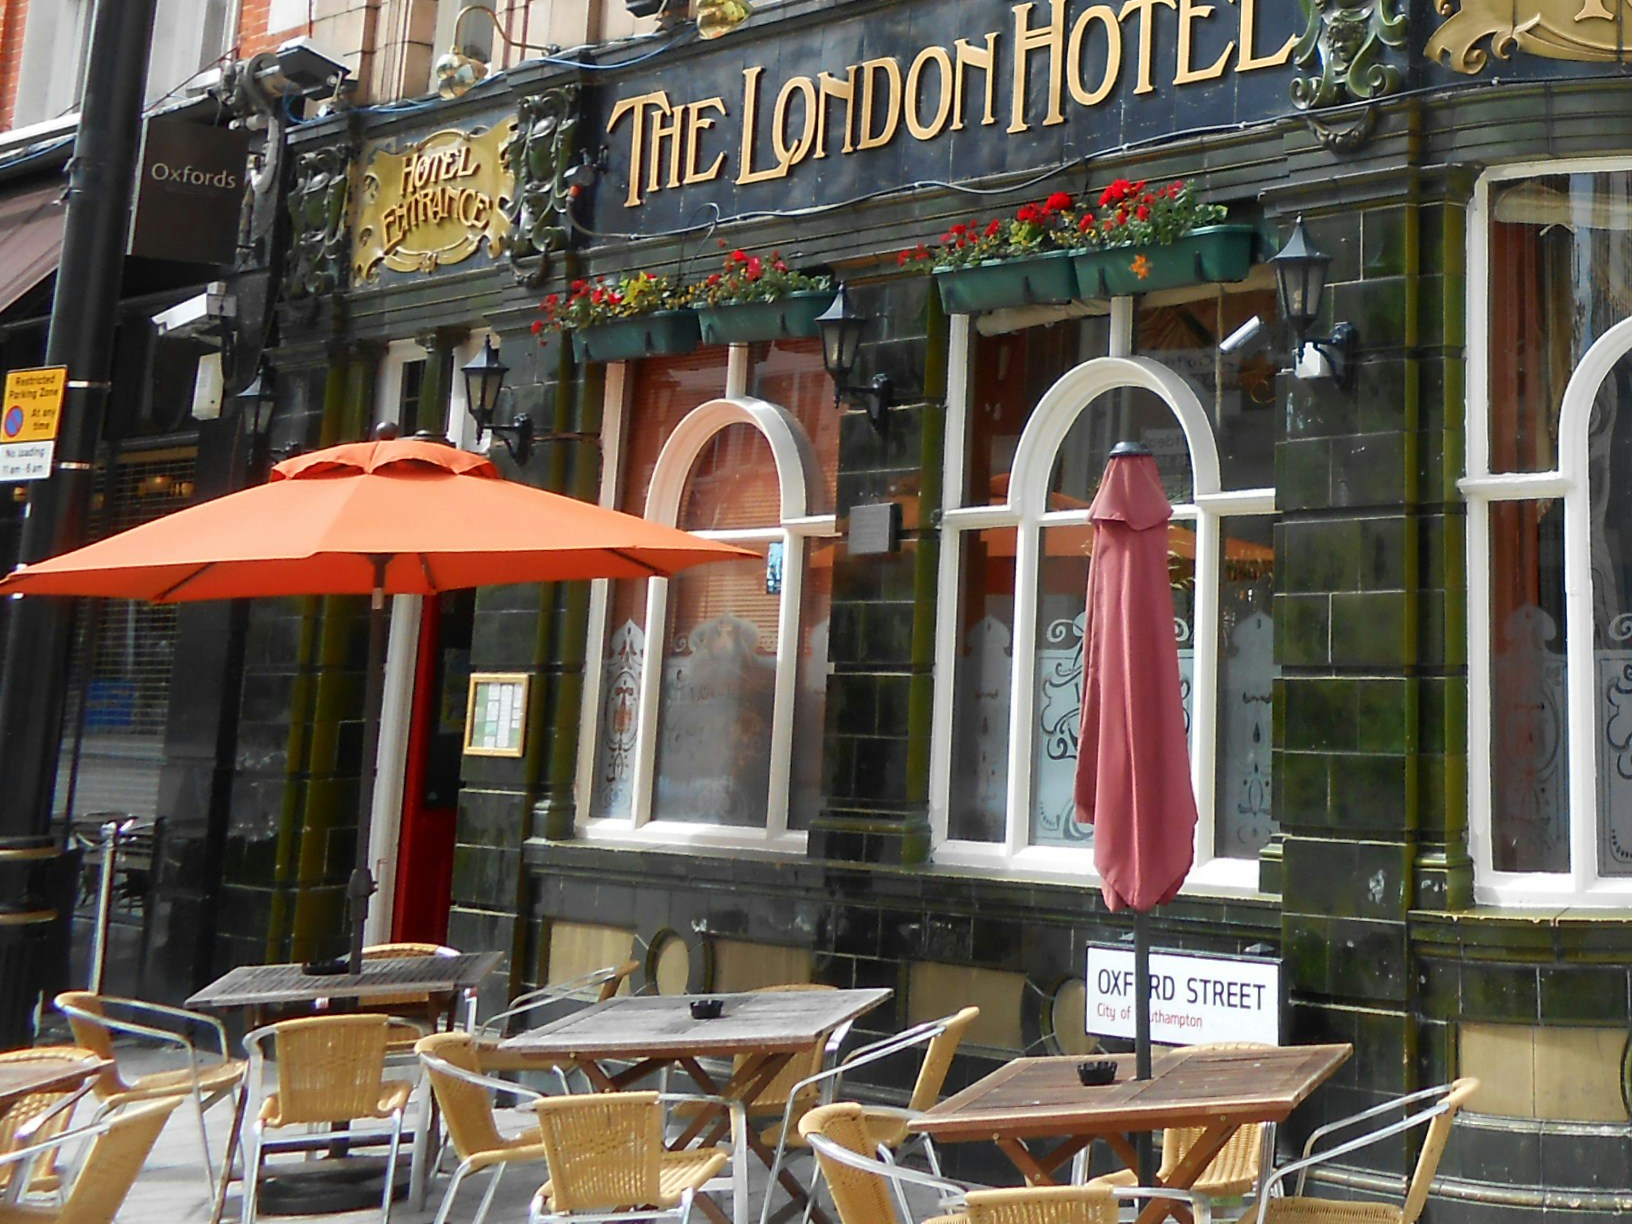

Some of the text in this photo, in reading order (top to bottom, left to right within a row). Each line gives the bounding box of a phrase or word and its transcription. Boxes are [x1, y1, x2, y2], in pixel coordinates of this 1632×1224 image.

[607, 90, 727, 208] THE
[735, 31, 996, 187] LONDON
[152, 163, 236, 188] Oxfords
[401, 146, 480, 196] HOTEL
[382, 186, 493, 254] ENTRANCE
[9, 387, 58, 400] Parking Zone
[15, 375, 56, 385] Restricted
[1097, 968, 1266, 1010] OXFRD STREET
[1097, 1003, 1203, 1028] City of uthampton
